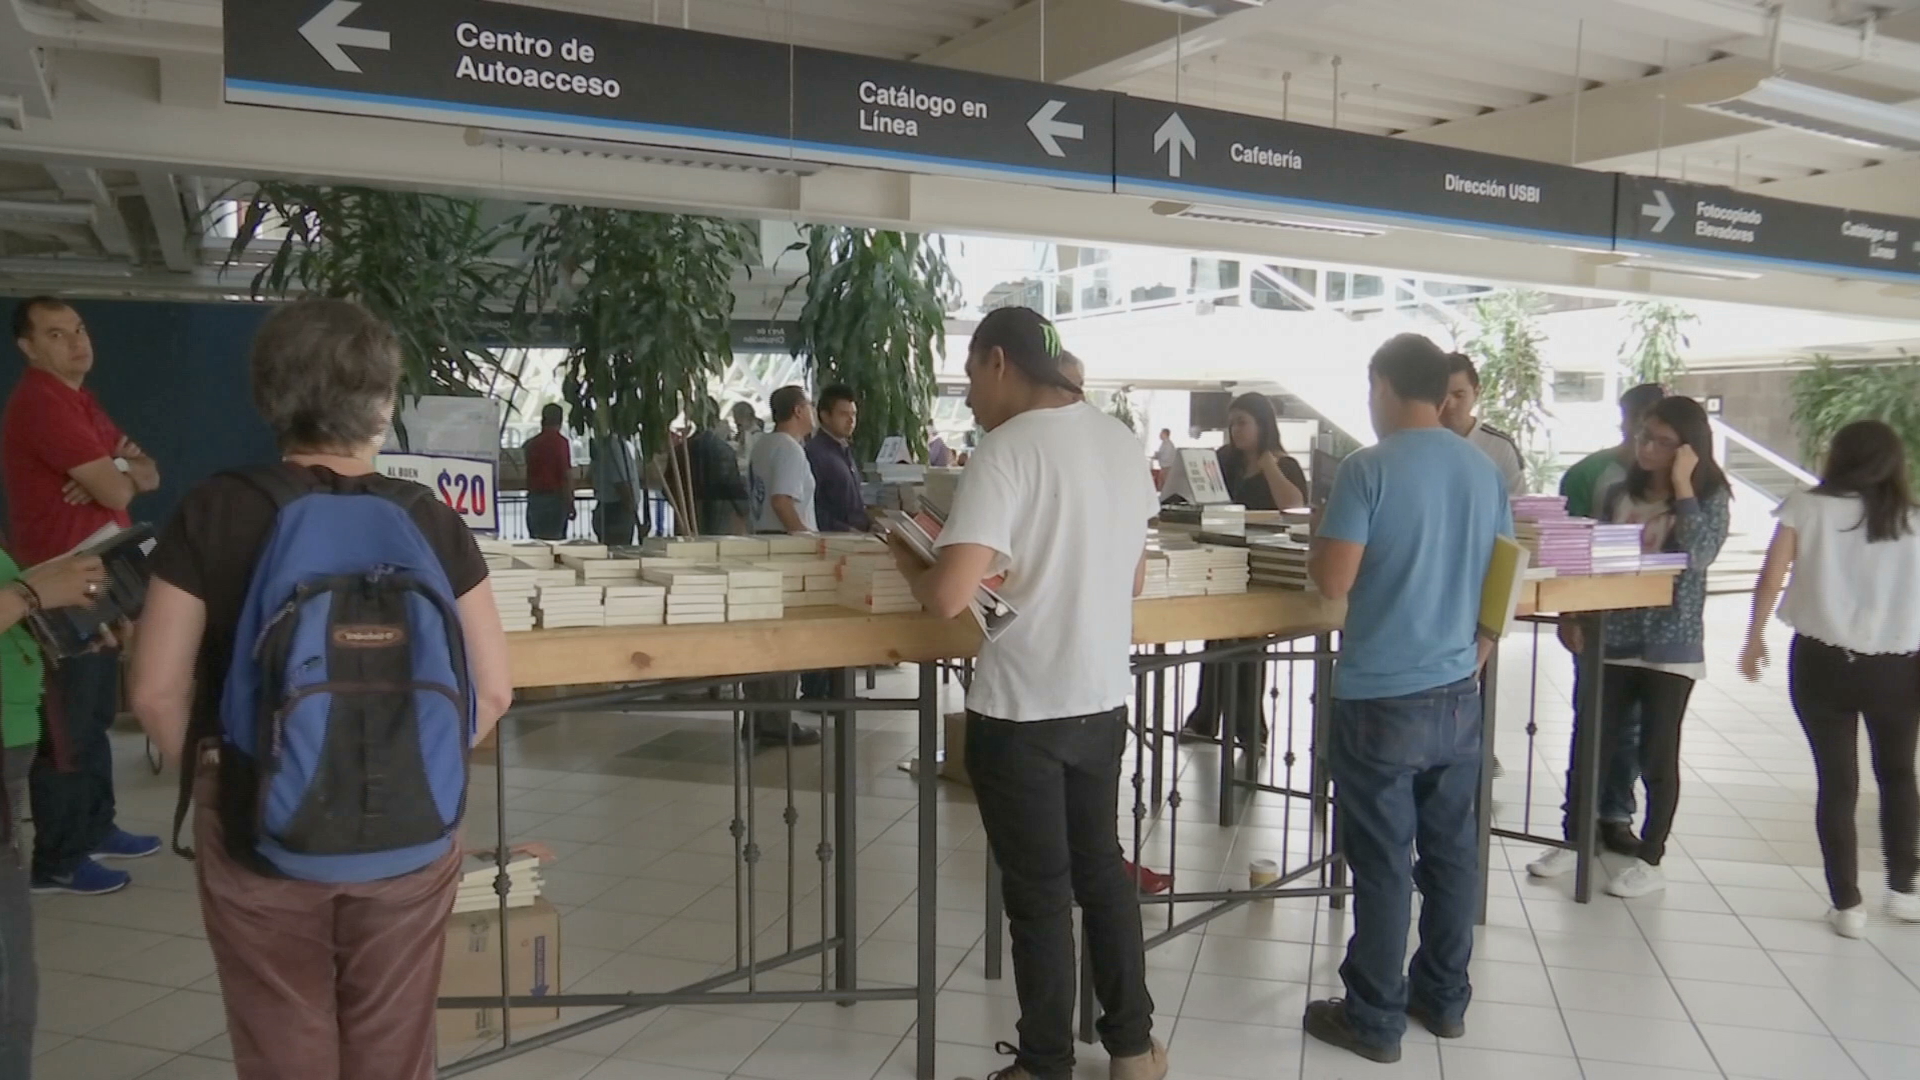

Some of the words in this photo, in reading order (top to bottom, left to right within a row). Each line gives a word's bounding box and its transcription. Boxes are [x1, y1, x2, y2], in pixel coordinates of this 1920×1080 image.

[456, 23, 552, 58] Centro
[561, 38, 595, 64] de
[456, 55, 620, 98] Autoacceso
[859, 81, 956, 117] Catálogo
[962, 101, 988, 119] en
[860, 109, 918, 137] Línea
[1230, 143, 1302, 170] Cafetería
[1445, 173, 1507, 198] Dirección
[1509, 183, 1541, 203] USBI
[1696, 201, 1763, 225] Fotocopiado
[387, 466, 396, 477] AL
[398, 467, 419, 479] BUEN
[437, 468, 486, 516] $20
